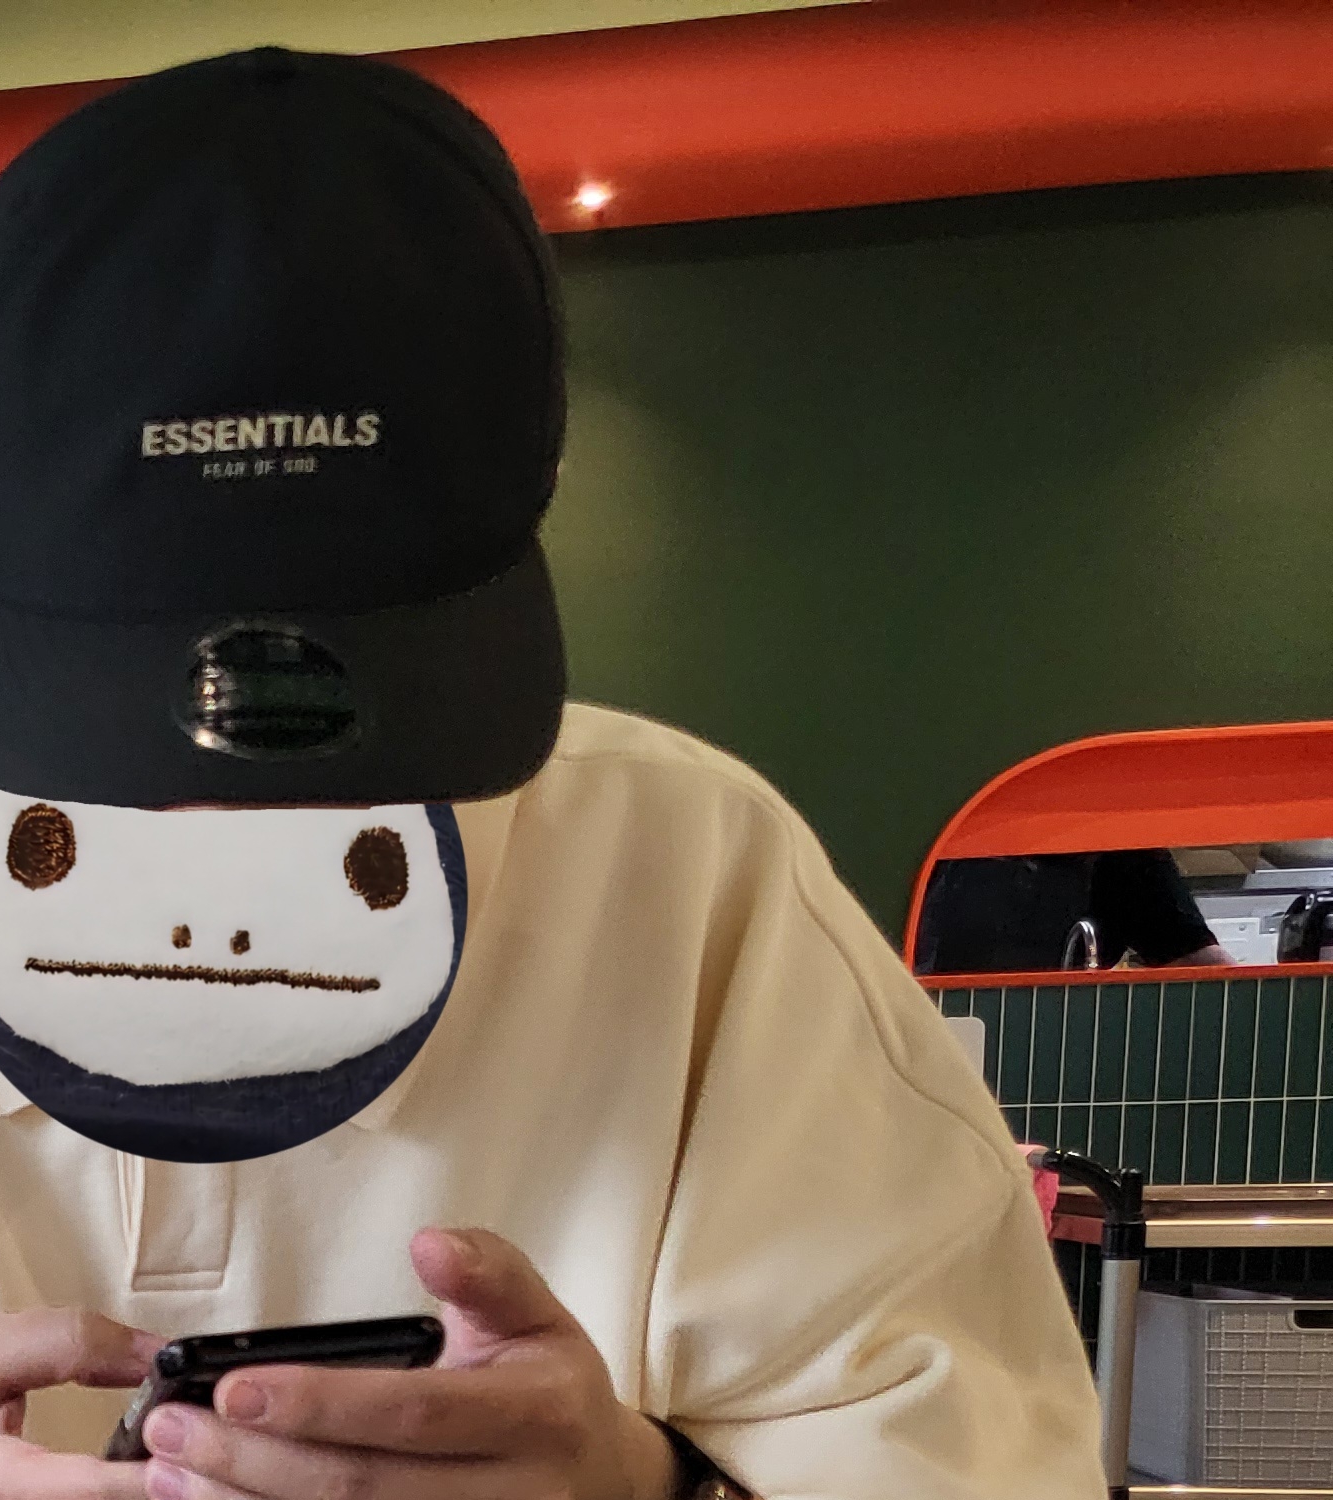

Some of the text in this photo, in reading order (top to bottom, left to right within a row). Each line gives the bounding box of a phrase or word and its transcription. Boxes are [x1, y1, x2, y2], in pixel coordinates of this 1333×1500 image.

[142, 414, 380, 457] ESSENTIALS
[202, 461, 245, 479] FEAR
[254, 460, 276, 476] OF
